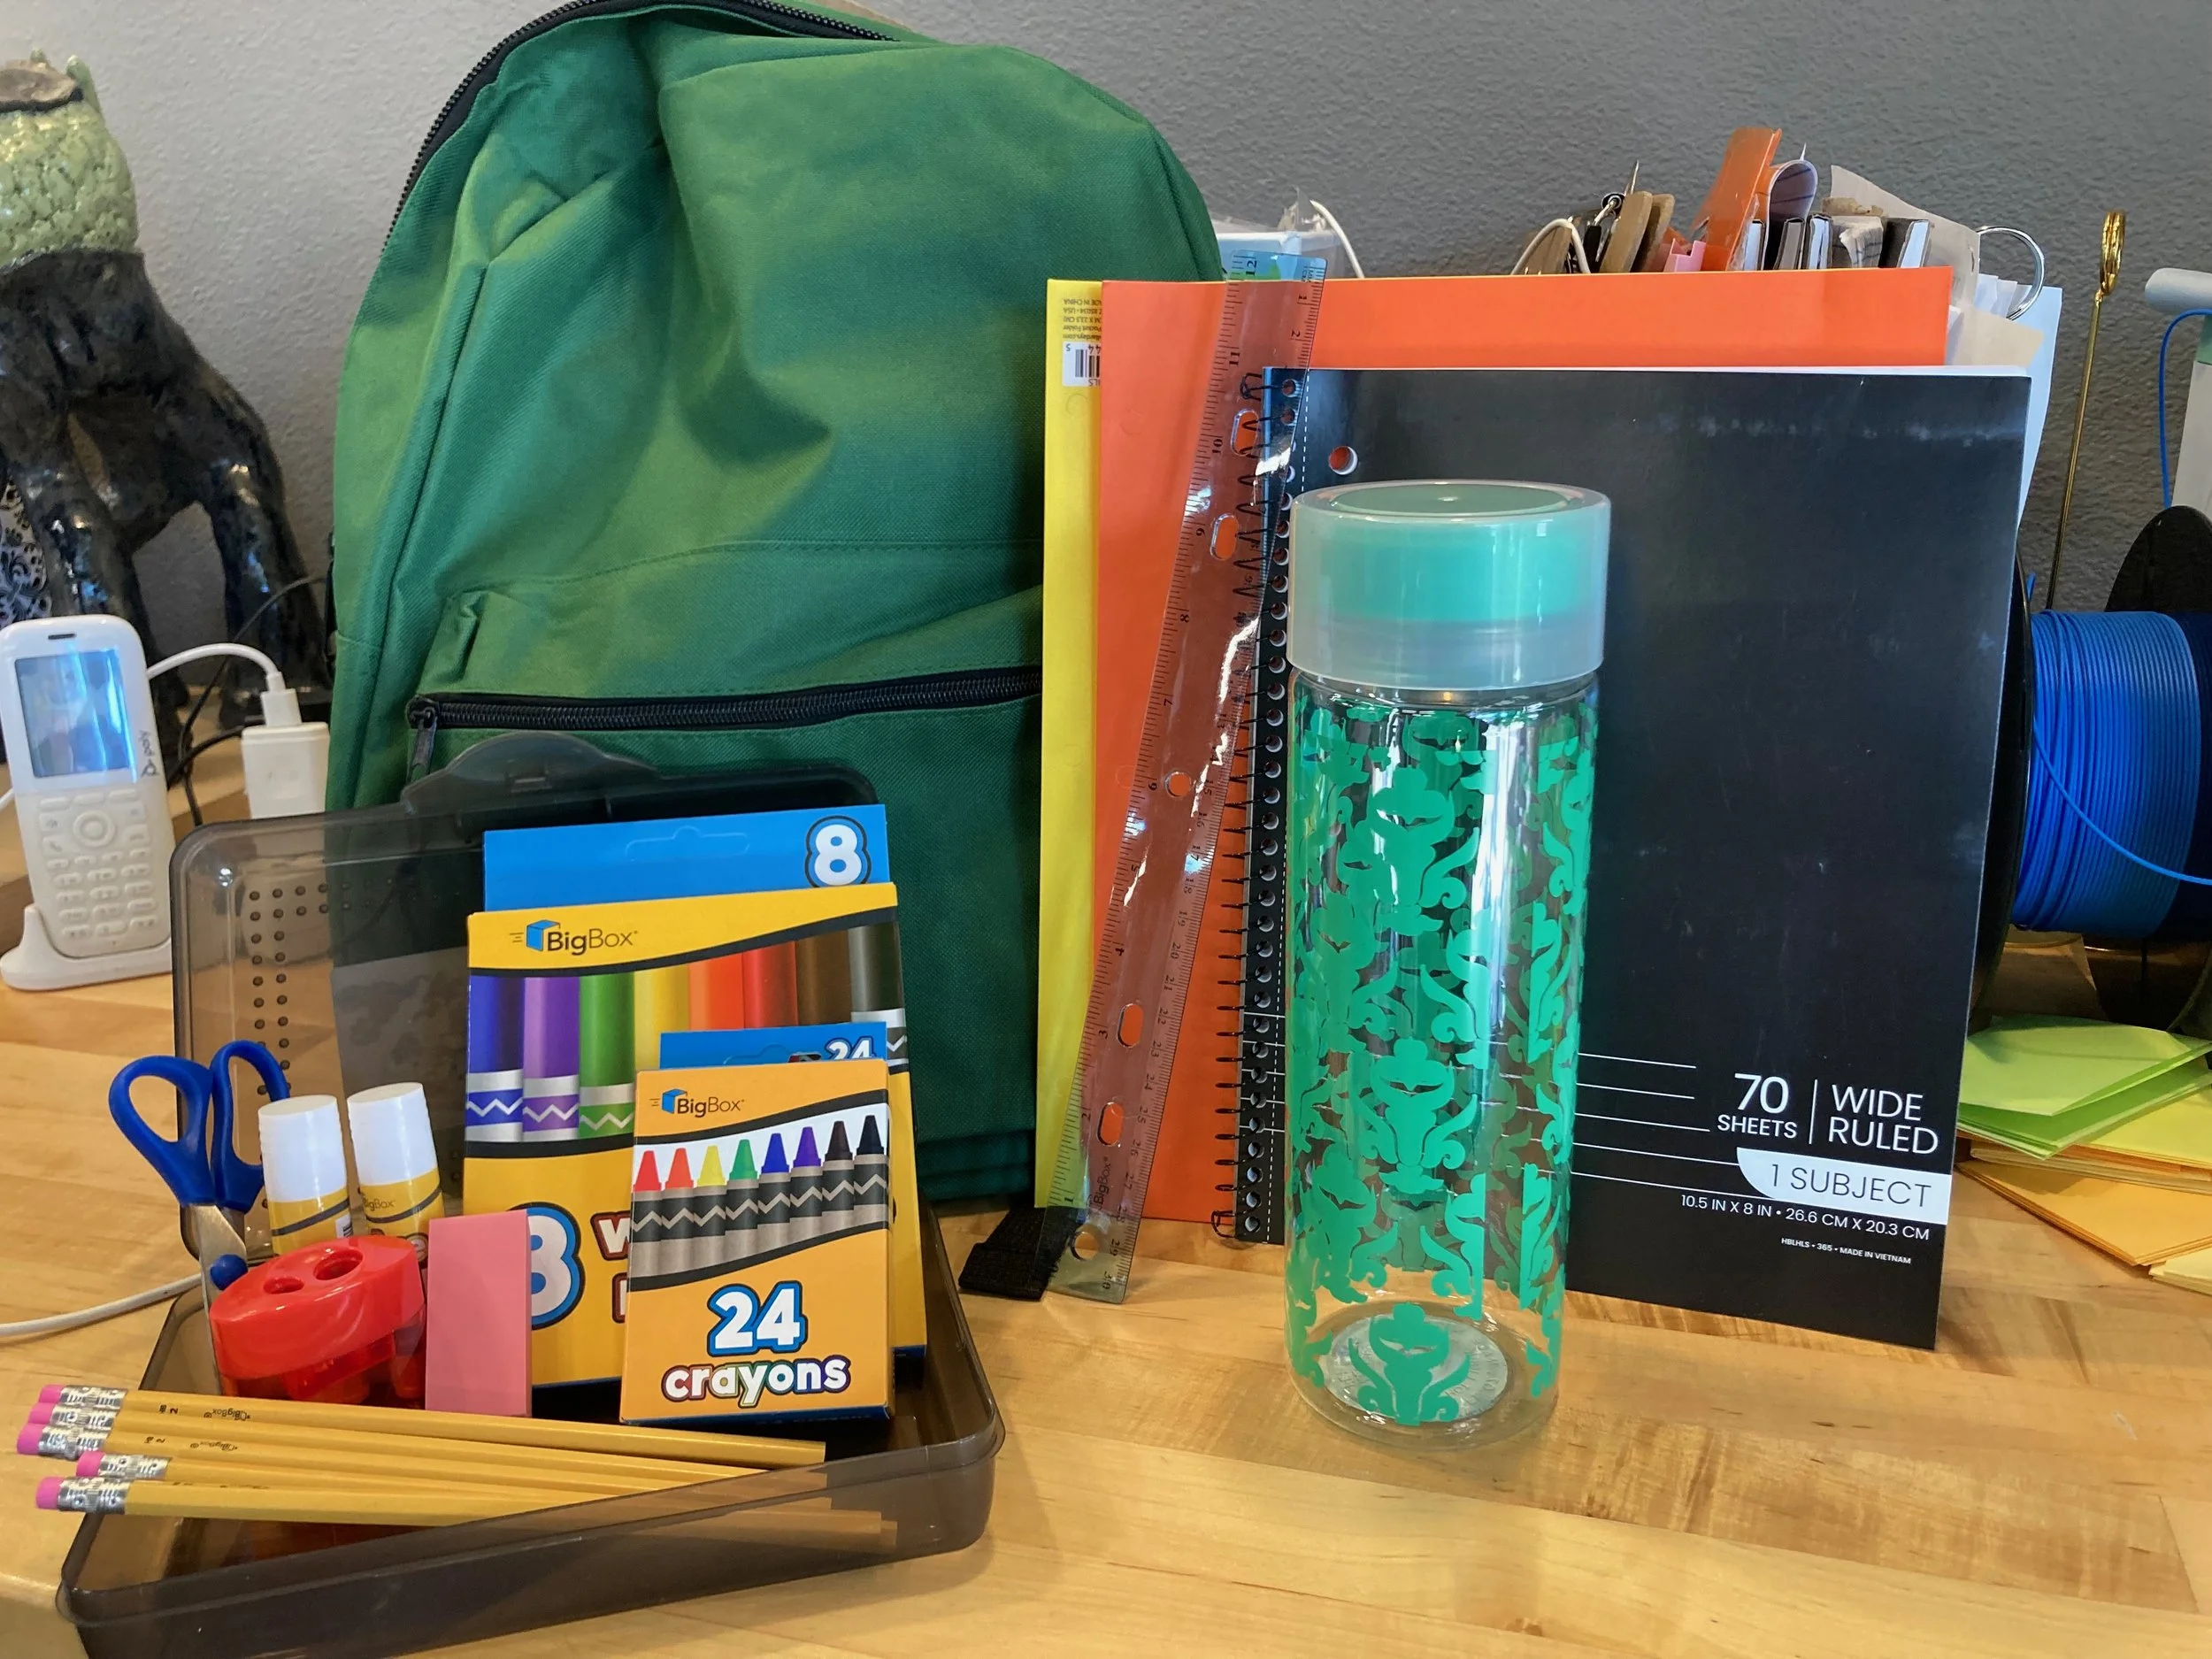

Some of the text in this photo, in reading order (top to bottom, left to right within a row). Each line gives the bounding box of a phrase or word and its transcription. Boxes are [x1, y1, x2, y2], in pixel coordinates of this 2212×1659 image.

[1245, 260, 1257, 276] 12
[1291, 329, 1301, 338] 2
[1229, 352, 1240, 365] 11
[1212, 438, 1223, 454] 10
[1195, 527, 1205, 536] 9
[1180, 613, 1190, 624] 8
[1164, 698, 1173, 707] 7
[1148, 782, 1157, 791] 6
[1203, 780, 1214, 796] 15
[1196, 811, 1207, 828] 16
[810, 820, 866, 886] 8
[1190, 845, 1201, 862] 17
[1132, 864, 1141, 873] 5
[1183, 878, 1194, 894] 18
[1177, 910, 1187, 926] 19
[547, 928, 634, 956] BigBox
[1171, 941, 1181, 959] 20
[1115, 948, 1125, 956] 4
[1164, 974, 1175, 991] 21
[1157, 1007, 1168, 1025] 22
[1098, 1030, 1108, 1040] 3
[826, 1038, 873, 1060] 24
[1150, 1041, 1162, 1058] 23
[1144, 1073, 1155, 1092] 24
[1734, 1072, 1789, 1114] 70
[676, 1096, 741, 1118] BigBox
[1832, 1084, 1924, 1121] WIDE
[1081, 1112, 1091, 1121] 2
[1137, 1106, 1148, 1124] 25
[1717, 1114, 1797, 1139] SHEETS
[1828, 1116, 1939, 1155] RULED
[1131, 1139, 1141, 1156] 26
[1124, 1172, 1134, 1190] 27
[1771, 1164, 1932, 1208] 1 SUBJECT
[1681, 1194, 1930, 1240] 10.5 IN X 8 IN 26.6 CM X 20.3 CM
[1110, 1239, 1121, 1256] 29
[1781, 1238, 1810, 1248] HBLHLS
[1816, 1242, 1832, 1252] 365
[1839, 1247, 1863, 1257] MADE
[1875, 1252, 1912, 1264] VIETNAM
[1103, 1271, 1113, 1290] 30
[710, 1285, 803, 1353] 24
[664, 1357, 849, 1405] crayons
